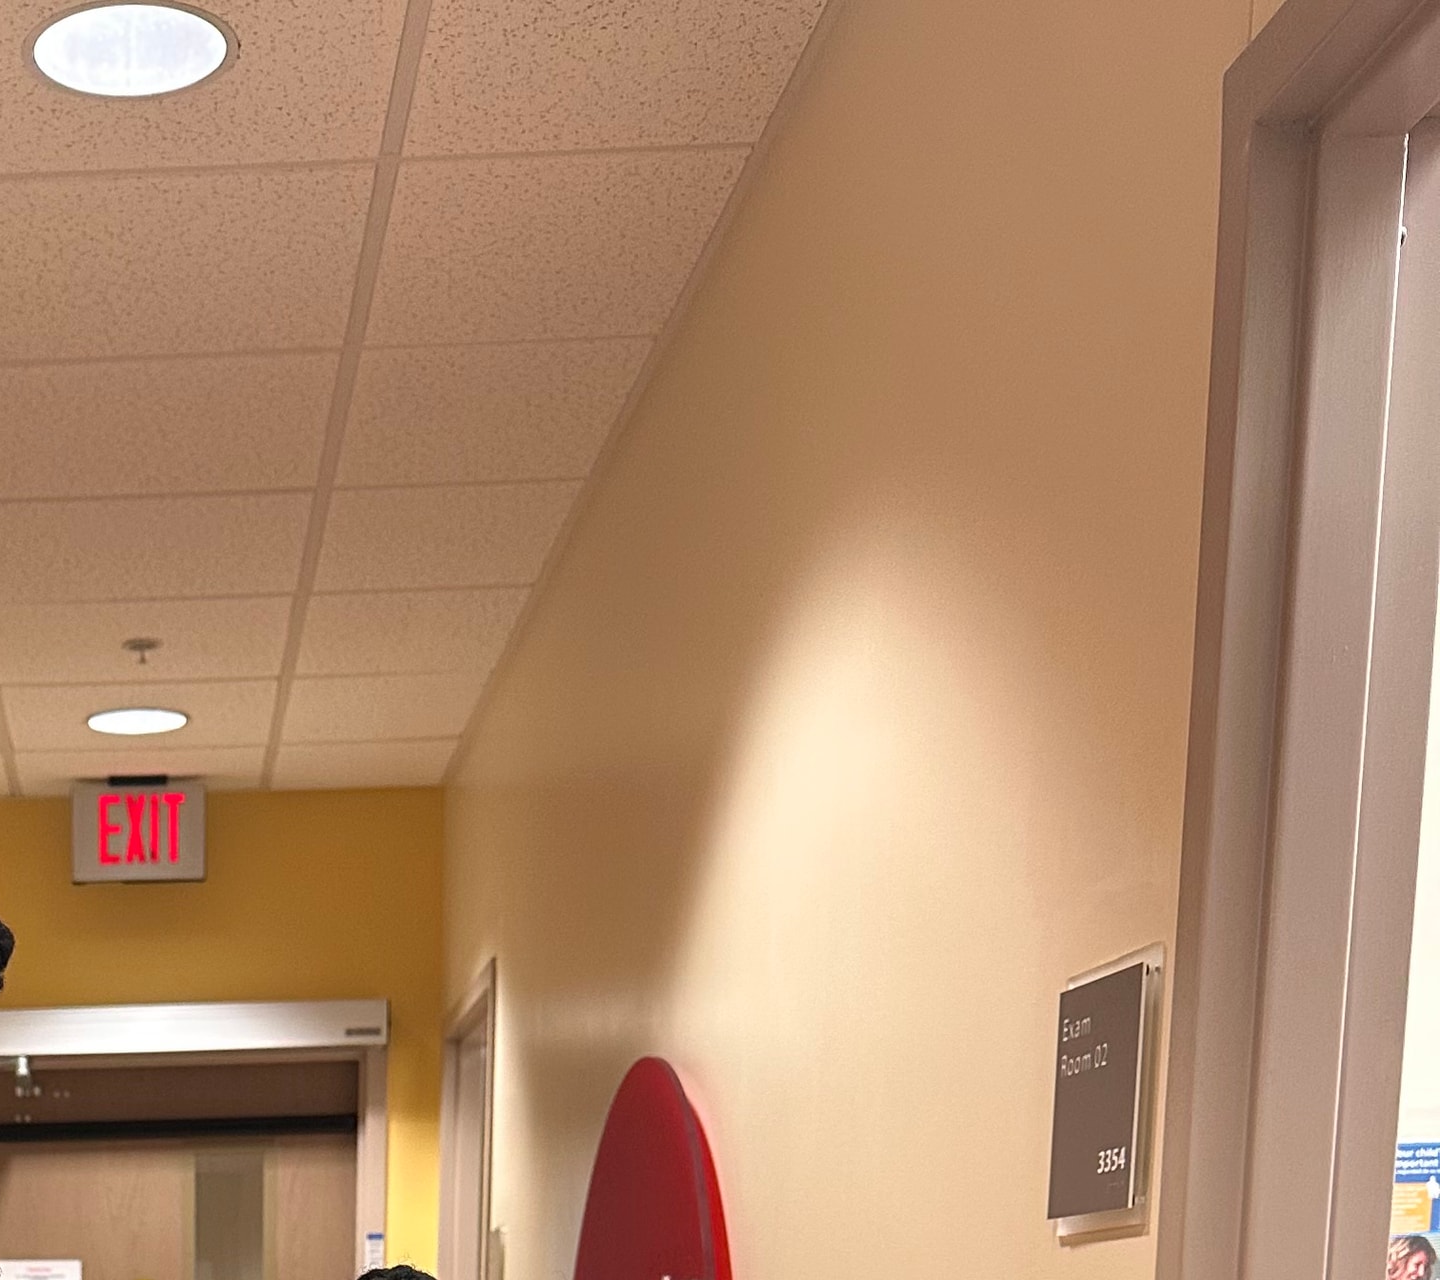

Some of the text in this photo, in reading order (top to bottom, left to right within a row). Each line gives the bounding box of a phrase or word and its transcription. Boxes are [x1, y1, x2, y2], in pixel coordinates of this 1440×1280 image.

[97, 793, 185, 865] EXIT
[1062, 1016, 1091, 1042] Exam
[1061, 1043, 1108, 1078] Room 02
[1097, 1147, 1126, 1174] 3354
